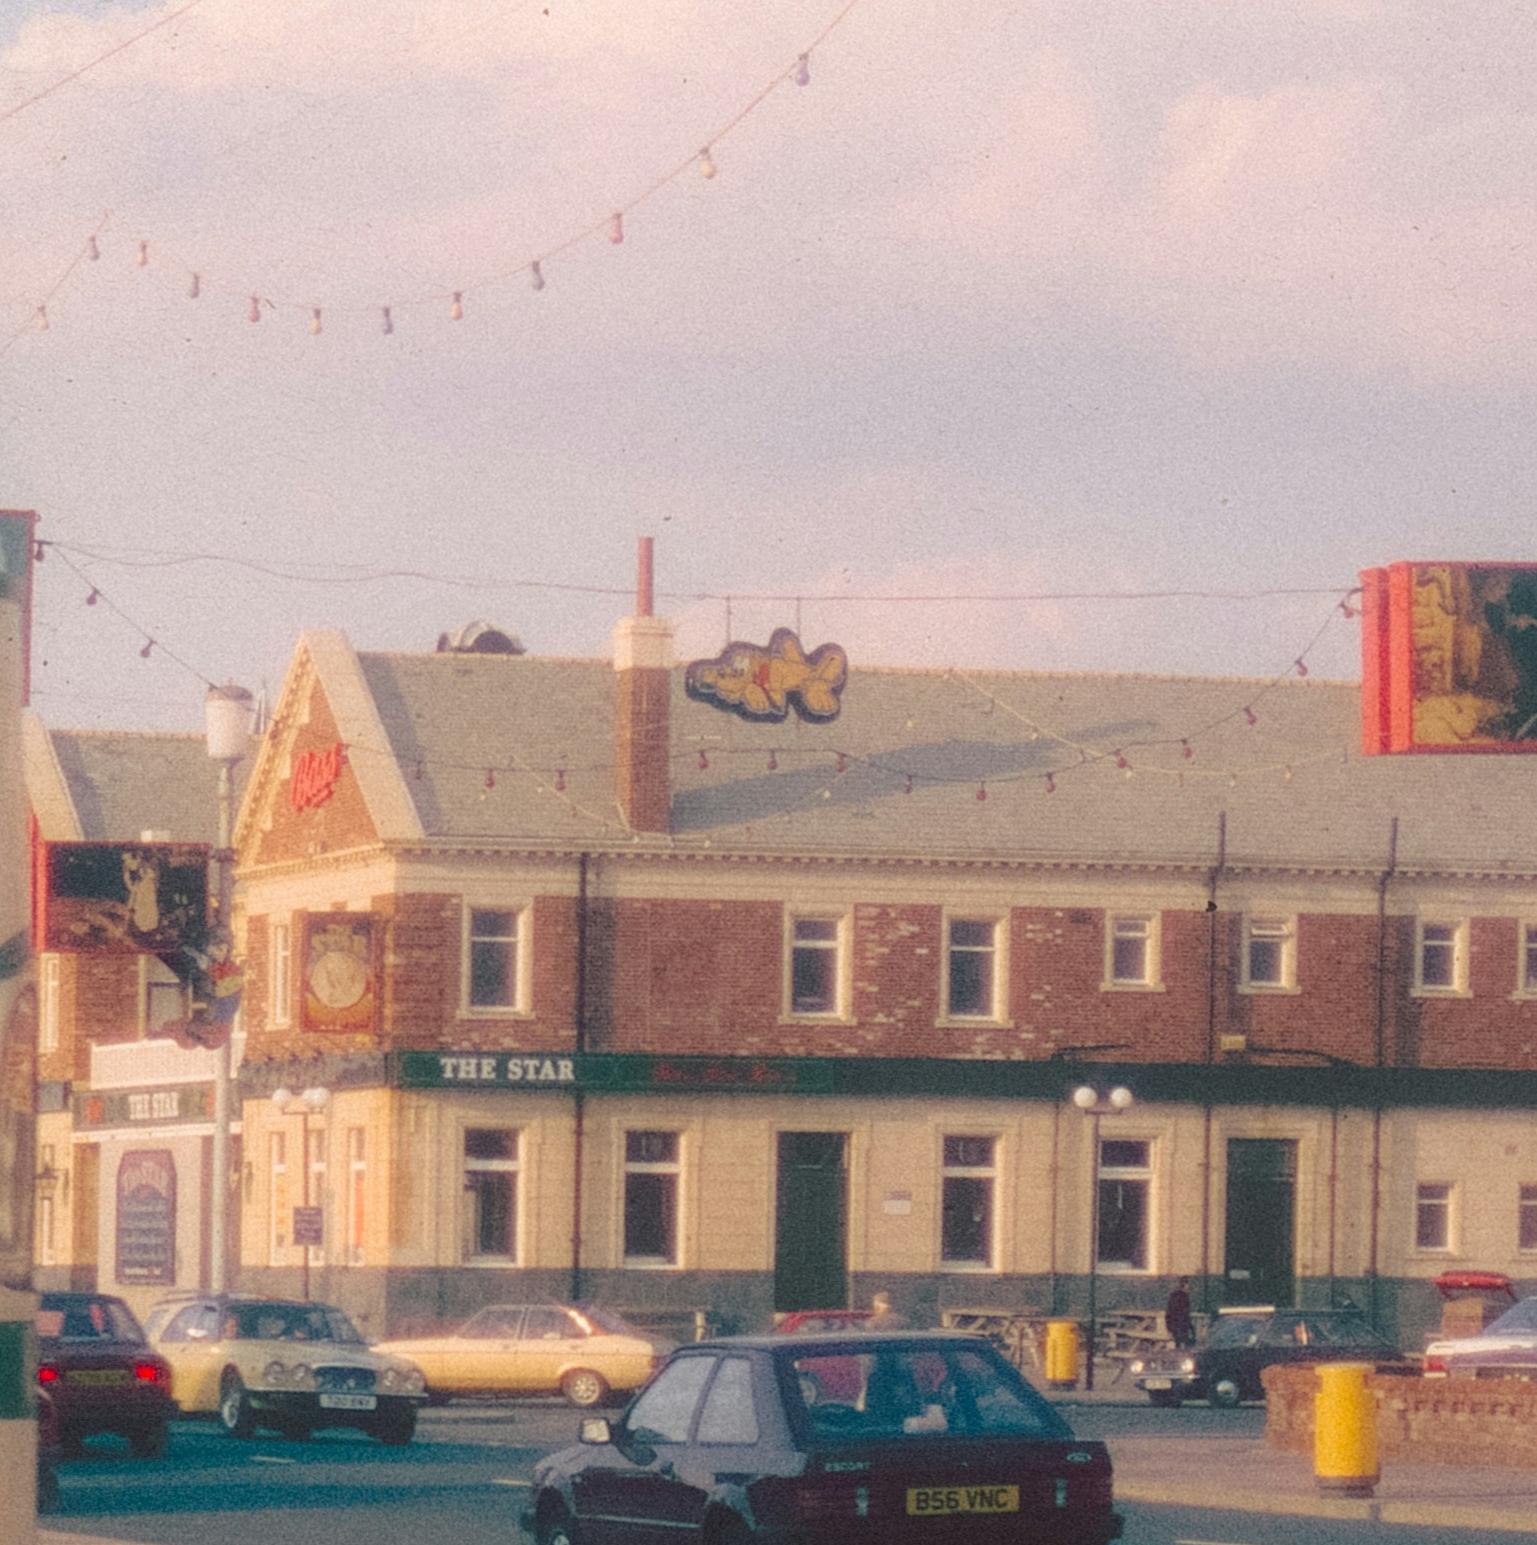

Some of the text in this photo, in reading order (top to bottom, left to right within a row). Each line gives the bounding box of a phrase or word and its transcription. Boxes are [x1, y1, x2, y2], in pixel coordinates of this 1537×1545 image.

[440, 1057, 575, 1081] THE STAR
[128, 1091, 179, 1119] THE STAR
[965, 1487, 1008, 1509] VNC
